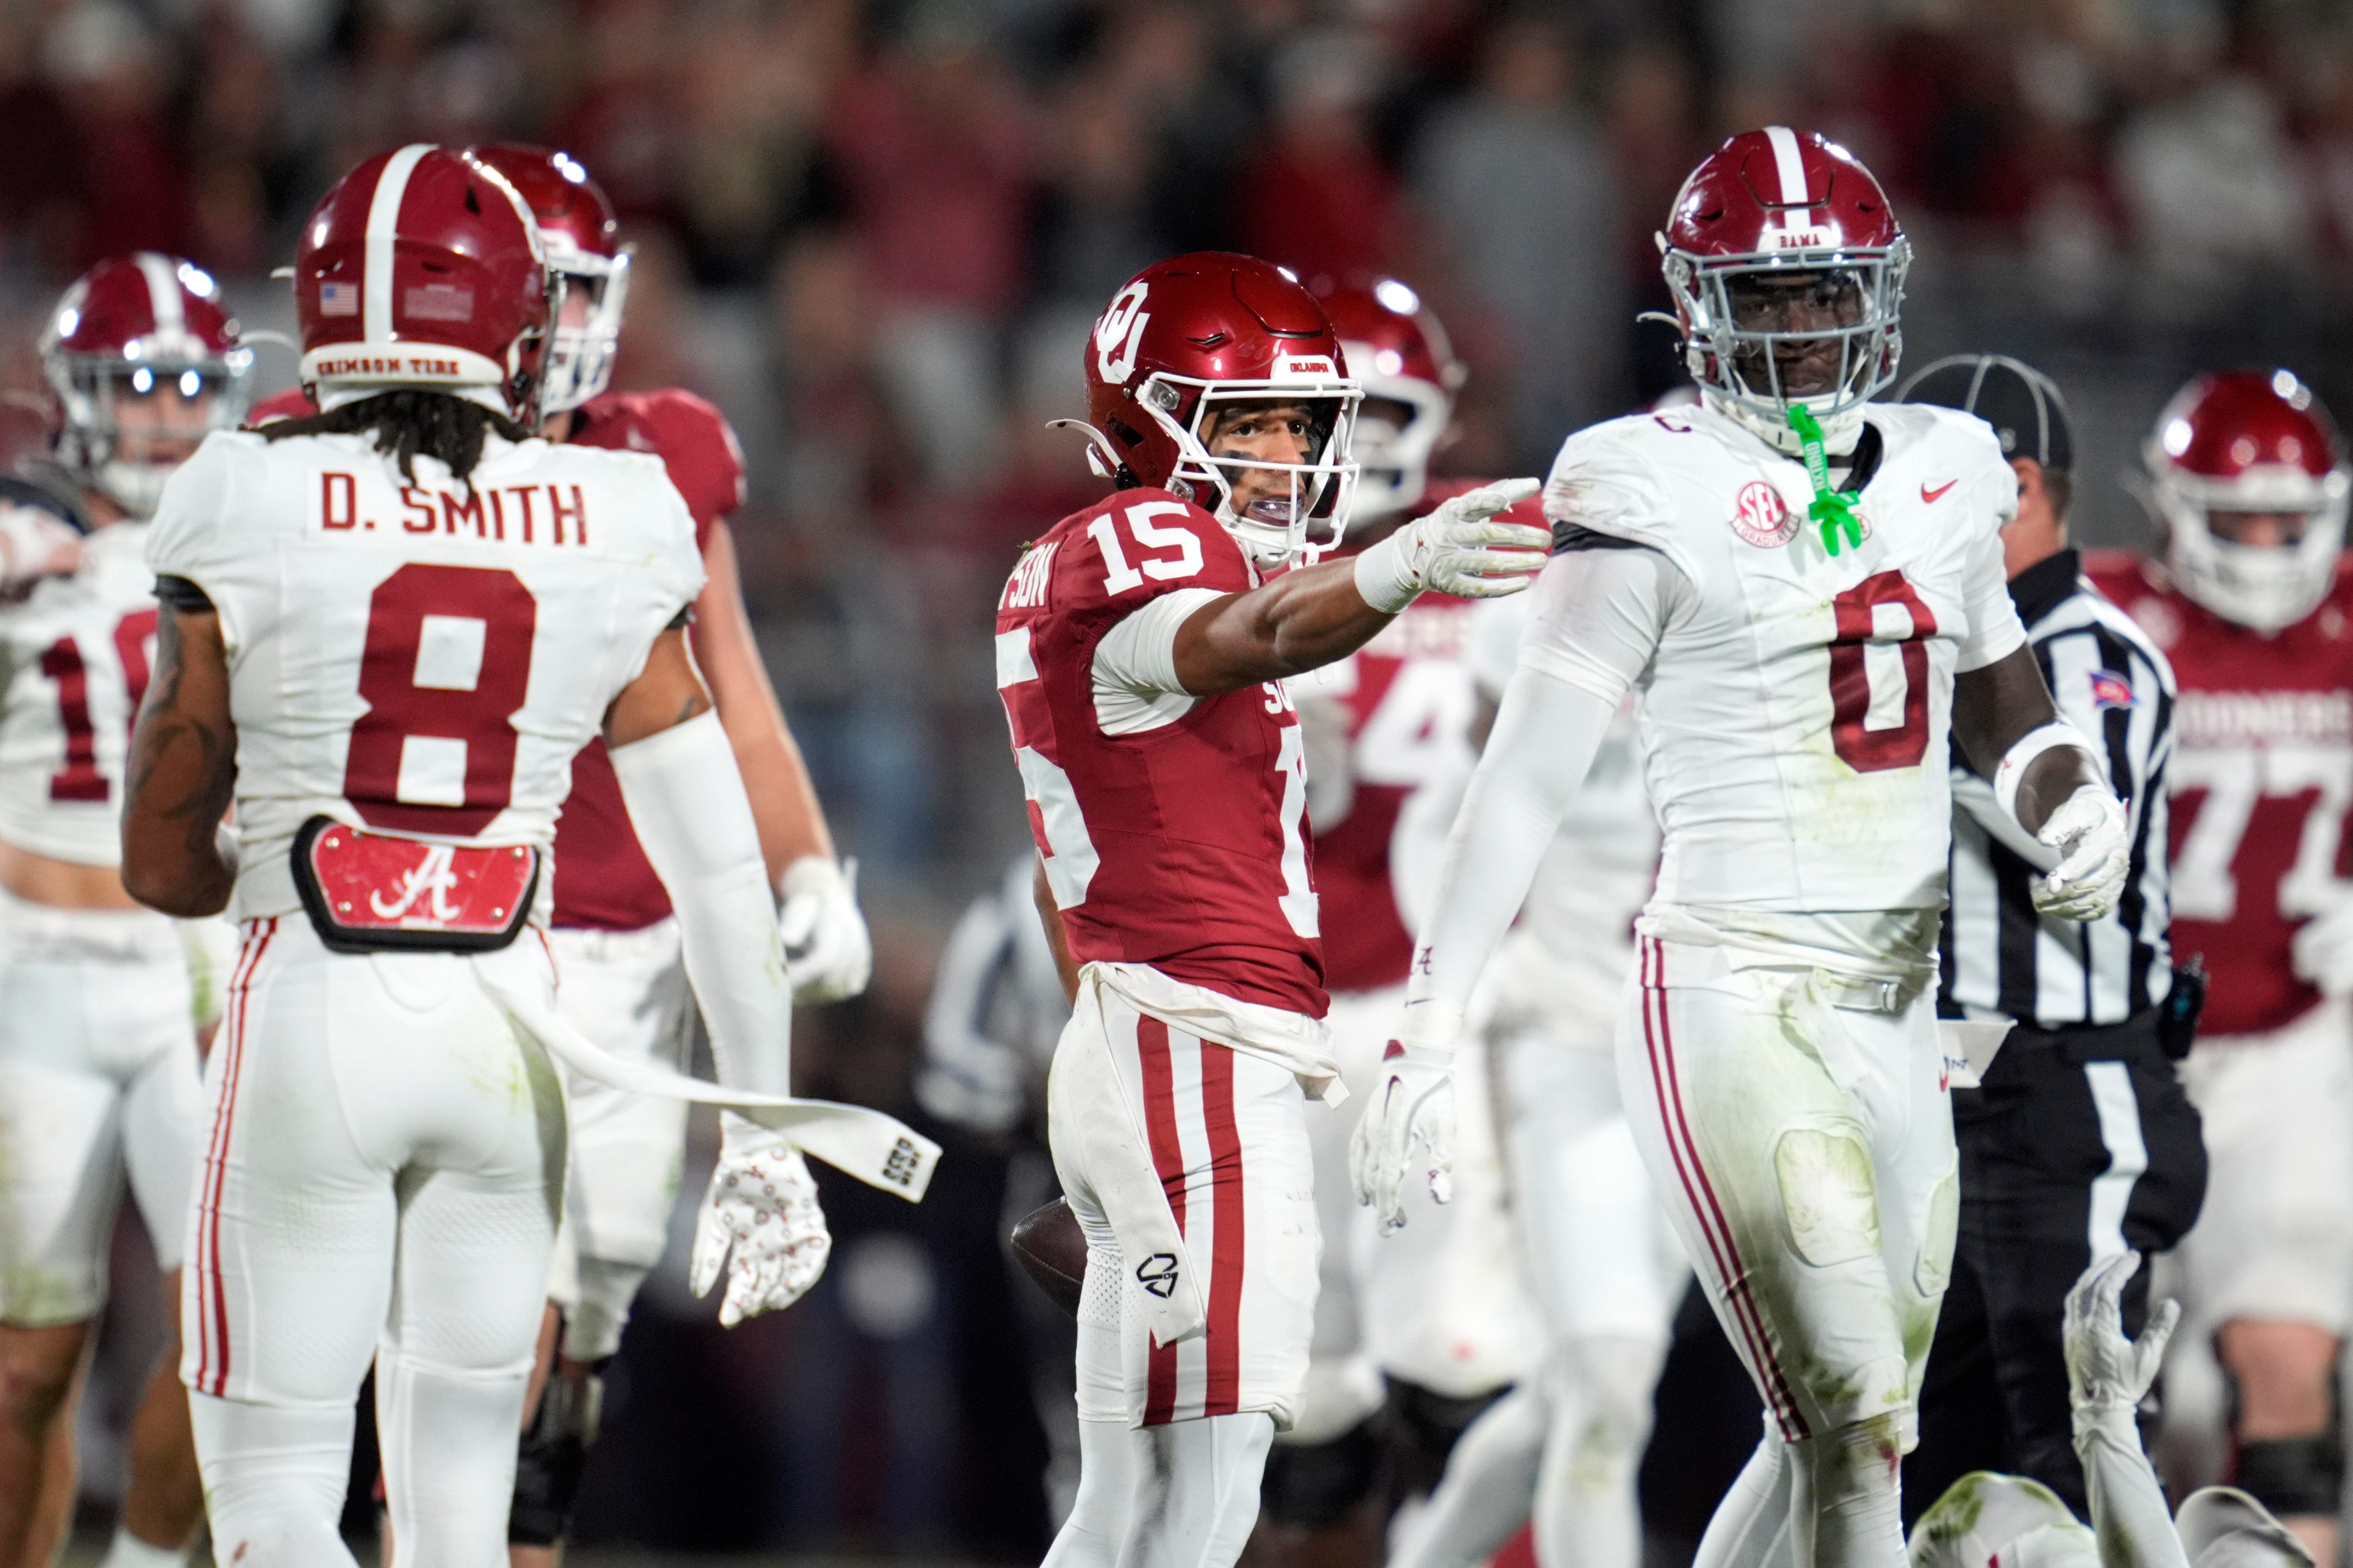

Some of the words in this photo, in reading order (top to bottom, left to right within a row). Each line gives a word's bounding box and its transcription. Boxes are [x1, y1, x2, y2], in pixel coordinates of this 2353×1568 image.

[1779, 234, 1820, 248] BAMA
[317, 358, 400, 375] CRIMSON
[409, 358, 459, 375] TIDE
[1290, 362, 1329, 372] OKLAHOMA
[322, 472, 375, 529] D.
[400, 485, 587, 544] SMITH
[1739, 483, 1784, 530] SEC
[1087, 501, 1204, 596] 15
[343, 562, 537, 837] 8
[1829, 569, 1938, 774] 0
[2169, 744, 2353, 921] 77
